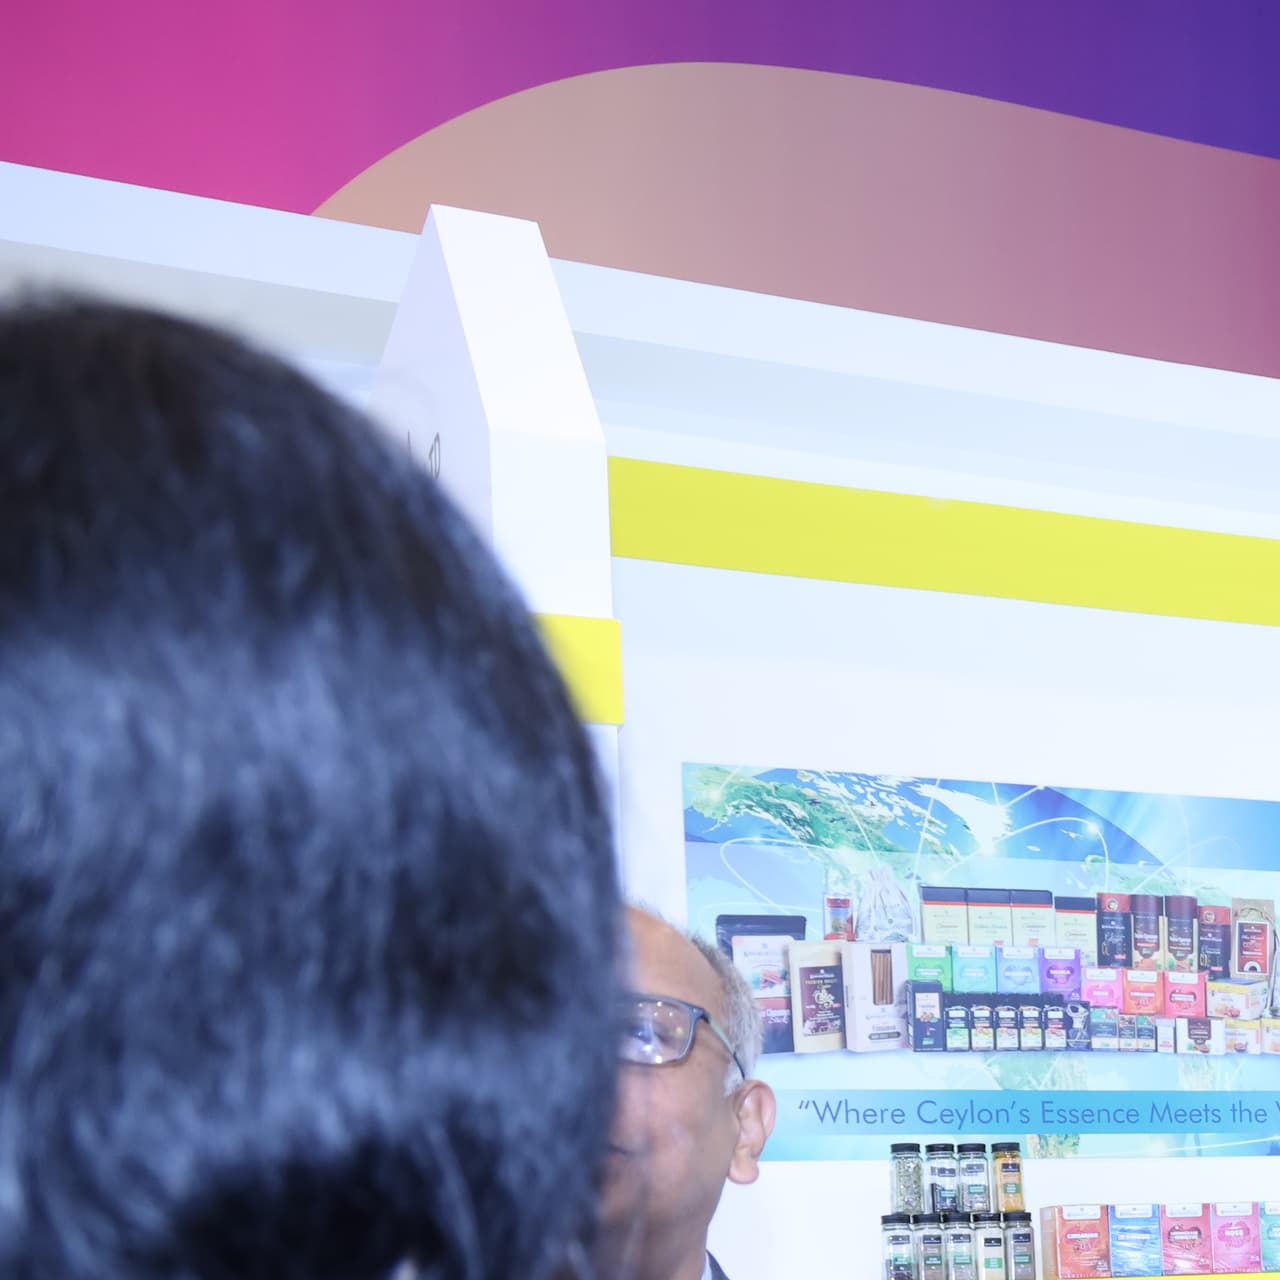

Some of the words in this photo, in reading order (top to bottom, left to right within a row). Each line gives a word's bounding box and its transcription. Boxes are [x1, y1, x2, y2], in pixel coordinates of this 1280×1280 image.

[916, 1100, 1030, 1131] Ceylon's
[1041, 1101, 1139, 1124] Essence
[1150, 1101, 1221, 1124] Meets
[1229, 1101, 1267, 1124] the
